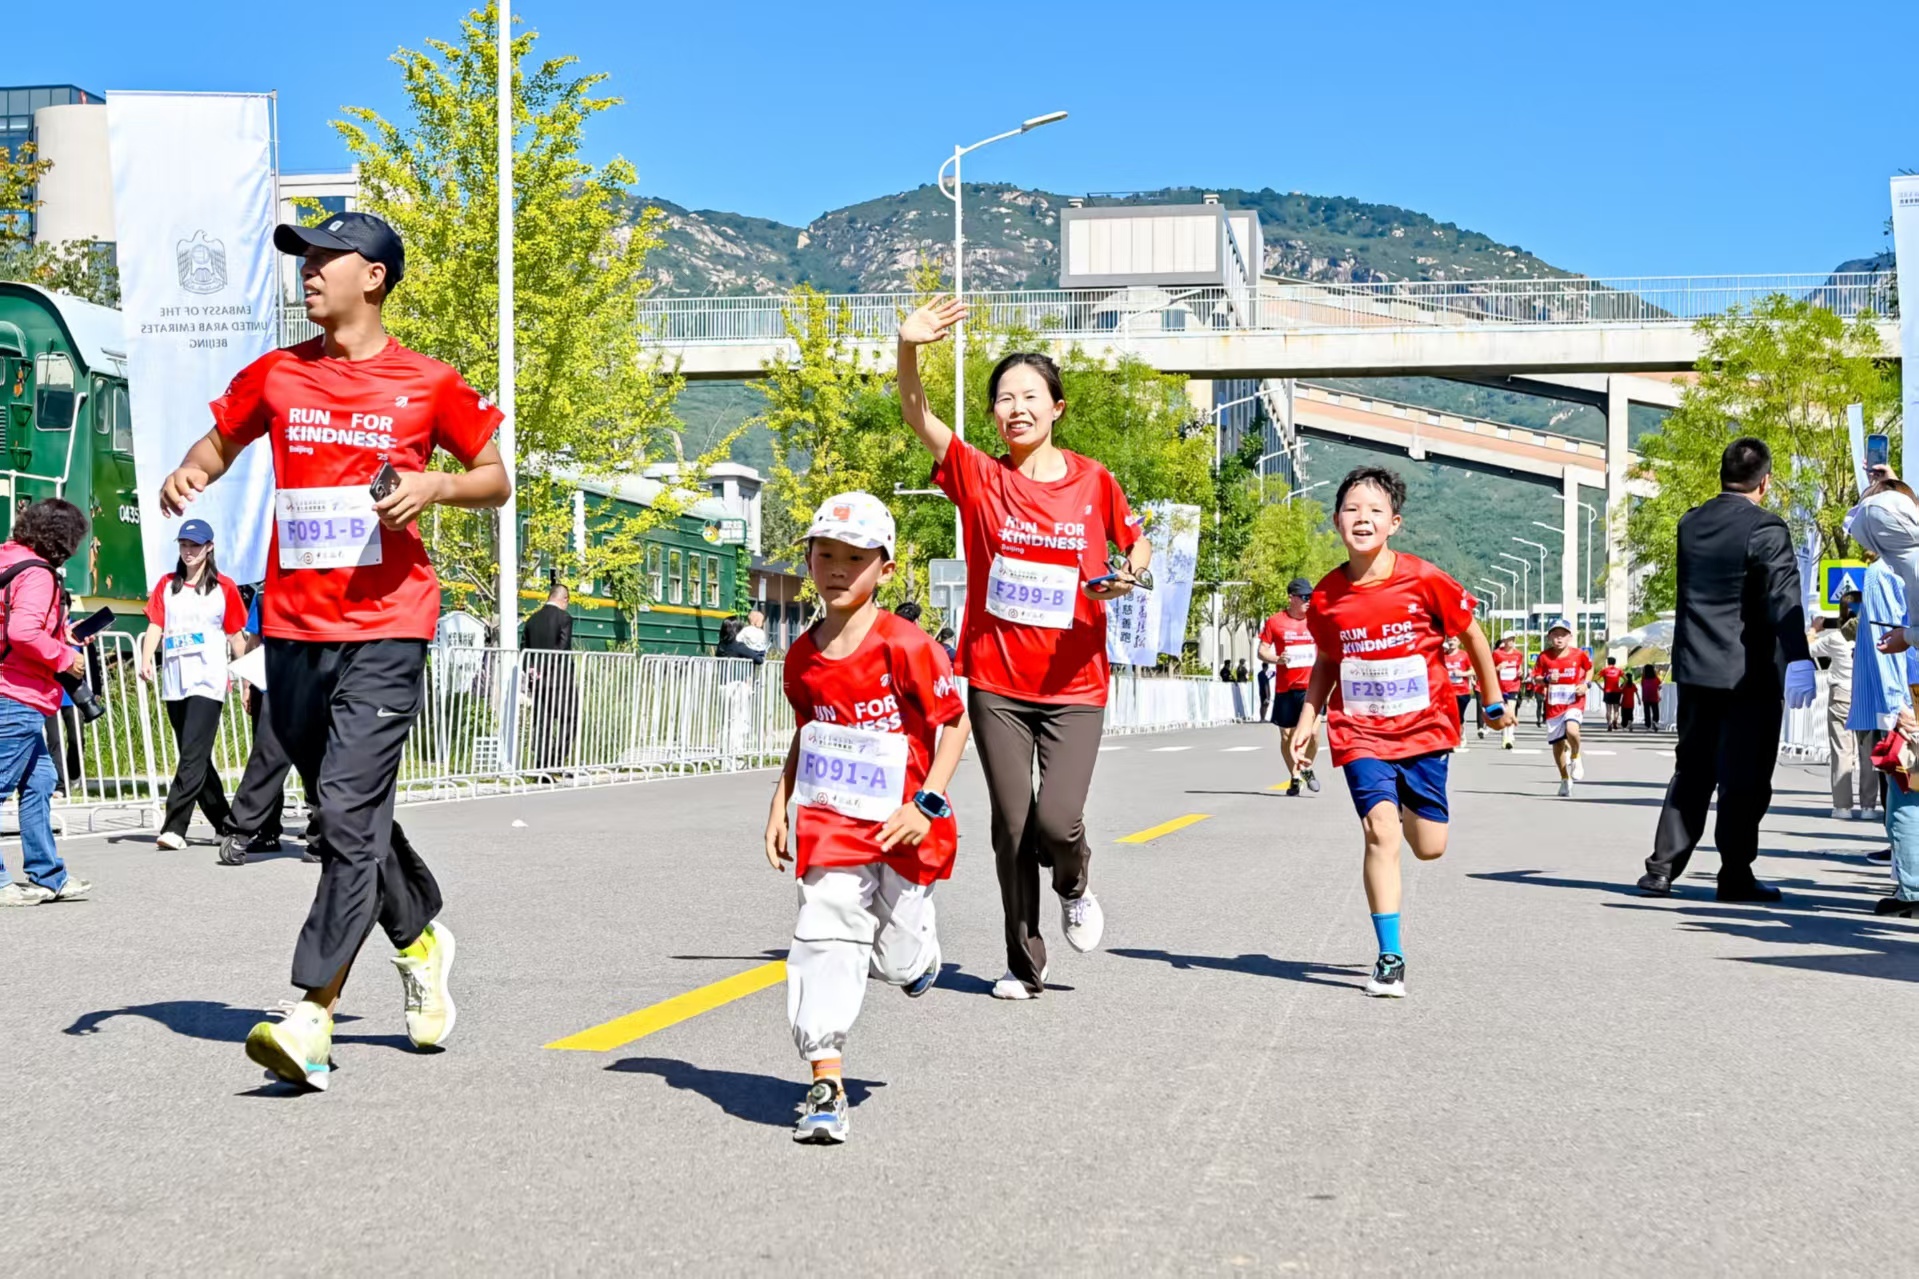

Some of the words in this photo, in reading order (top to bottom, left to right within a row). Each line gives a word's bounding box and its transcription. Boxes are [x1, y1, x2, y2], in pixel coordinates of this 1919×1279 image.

[289, 408, 331, 425] RUN
[351, 413, 393, 432] FOR
[287, 426, 392, 450] KINDNESS
[287, 518, 366, 541] F091-B
[1005, 515, 1037, 533] RUN
[1054, 522, 1085, 536] FOR
[1001, 528, 1086, 550] KINDNESS
[996, 580, 1065, 606] F299-B
[1340, 627, 1368, 641] RUN
[1382, 620, 1413, 637] FOR
[1351, 677, 1419, 697] F299-A
[813, 704, 837, 722] UN
[854, 694, 899, 719] FOR
[804, 753, 887, 790] F091-A
